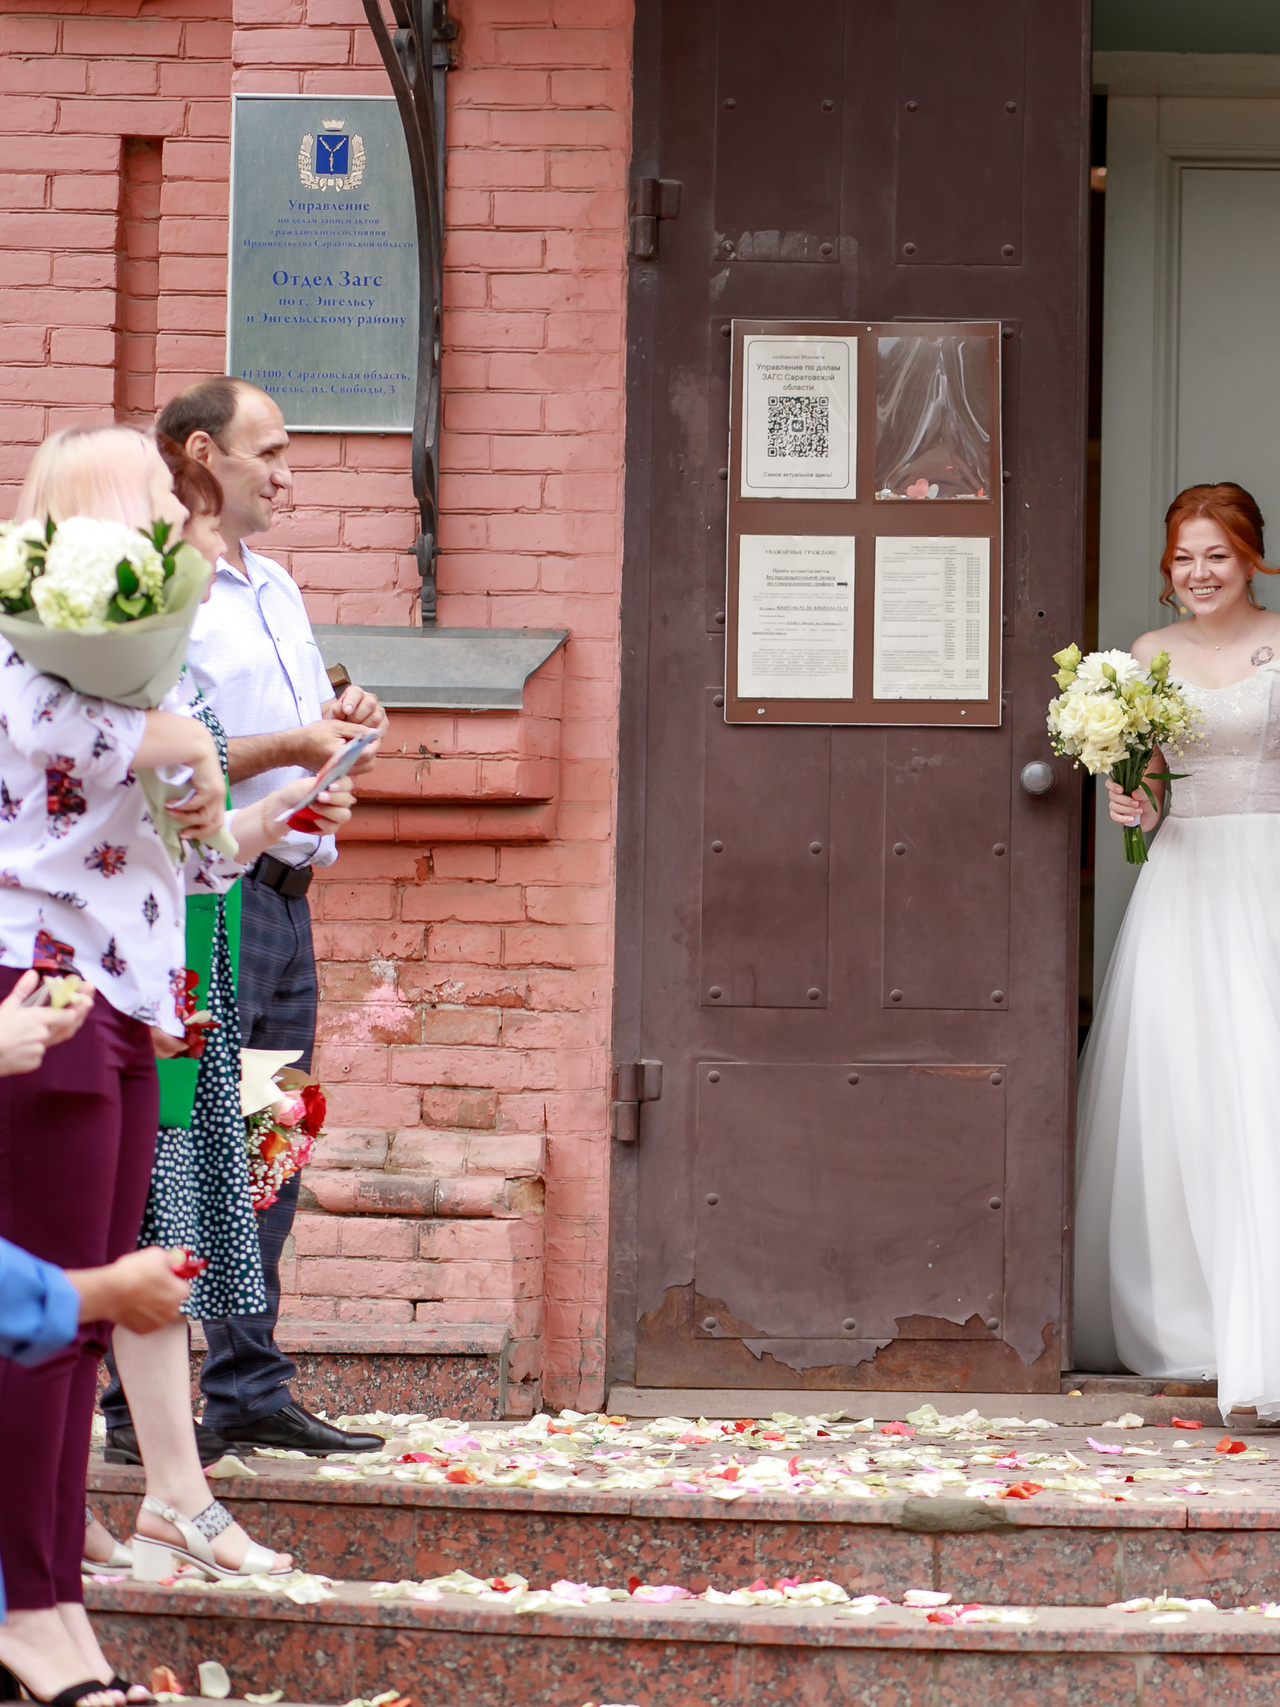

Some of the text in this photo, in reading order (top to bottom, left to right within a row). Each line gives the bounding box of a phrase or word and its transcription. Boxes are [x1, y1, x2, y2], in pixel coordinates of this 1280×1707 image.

[288, 199, 370, 213] Управление
[270, 229, 335, 237] гражданского
[243, 239, 414, 249] Правительства Саратовской области
[272, 270, 383, 288] Отдел Загс
[278, 296, 375, 309] по г. Энгельсу
[246, 312, 407, 327] и Энгельсскому району
[756, 363, 803, 371] Управление
[240, 369, 411, 382] 413100, Саратовская область,
[784, 373, 835, 382] Саратовской
[311, 386, 327, 394] пл.
[330, 384, 386, 395] Свободы,
[390, 385, 395, 394] 3
[782, 383, 814, 391] области
